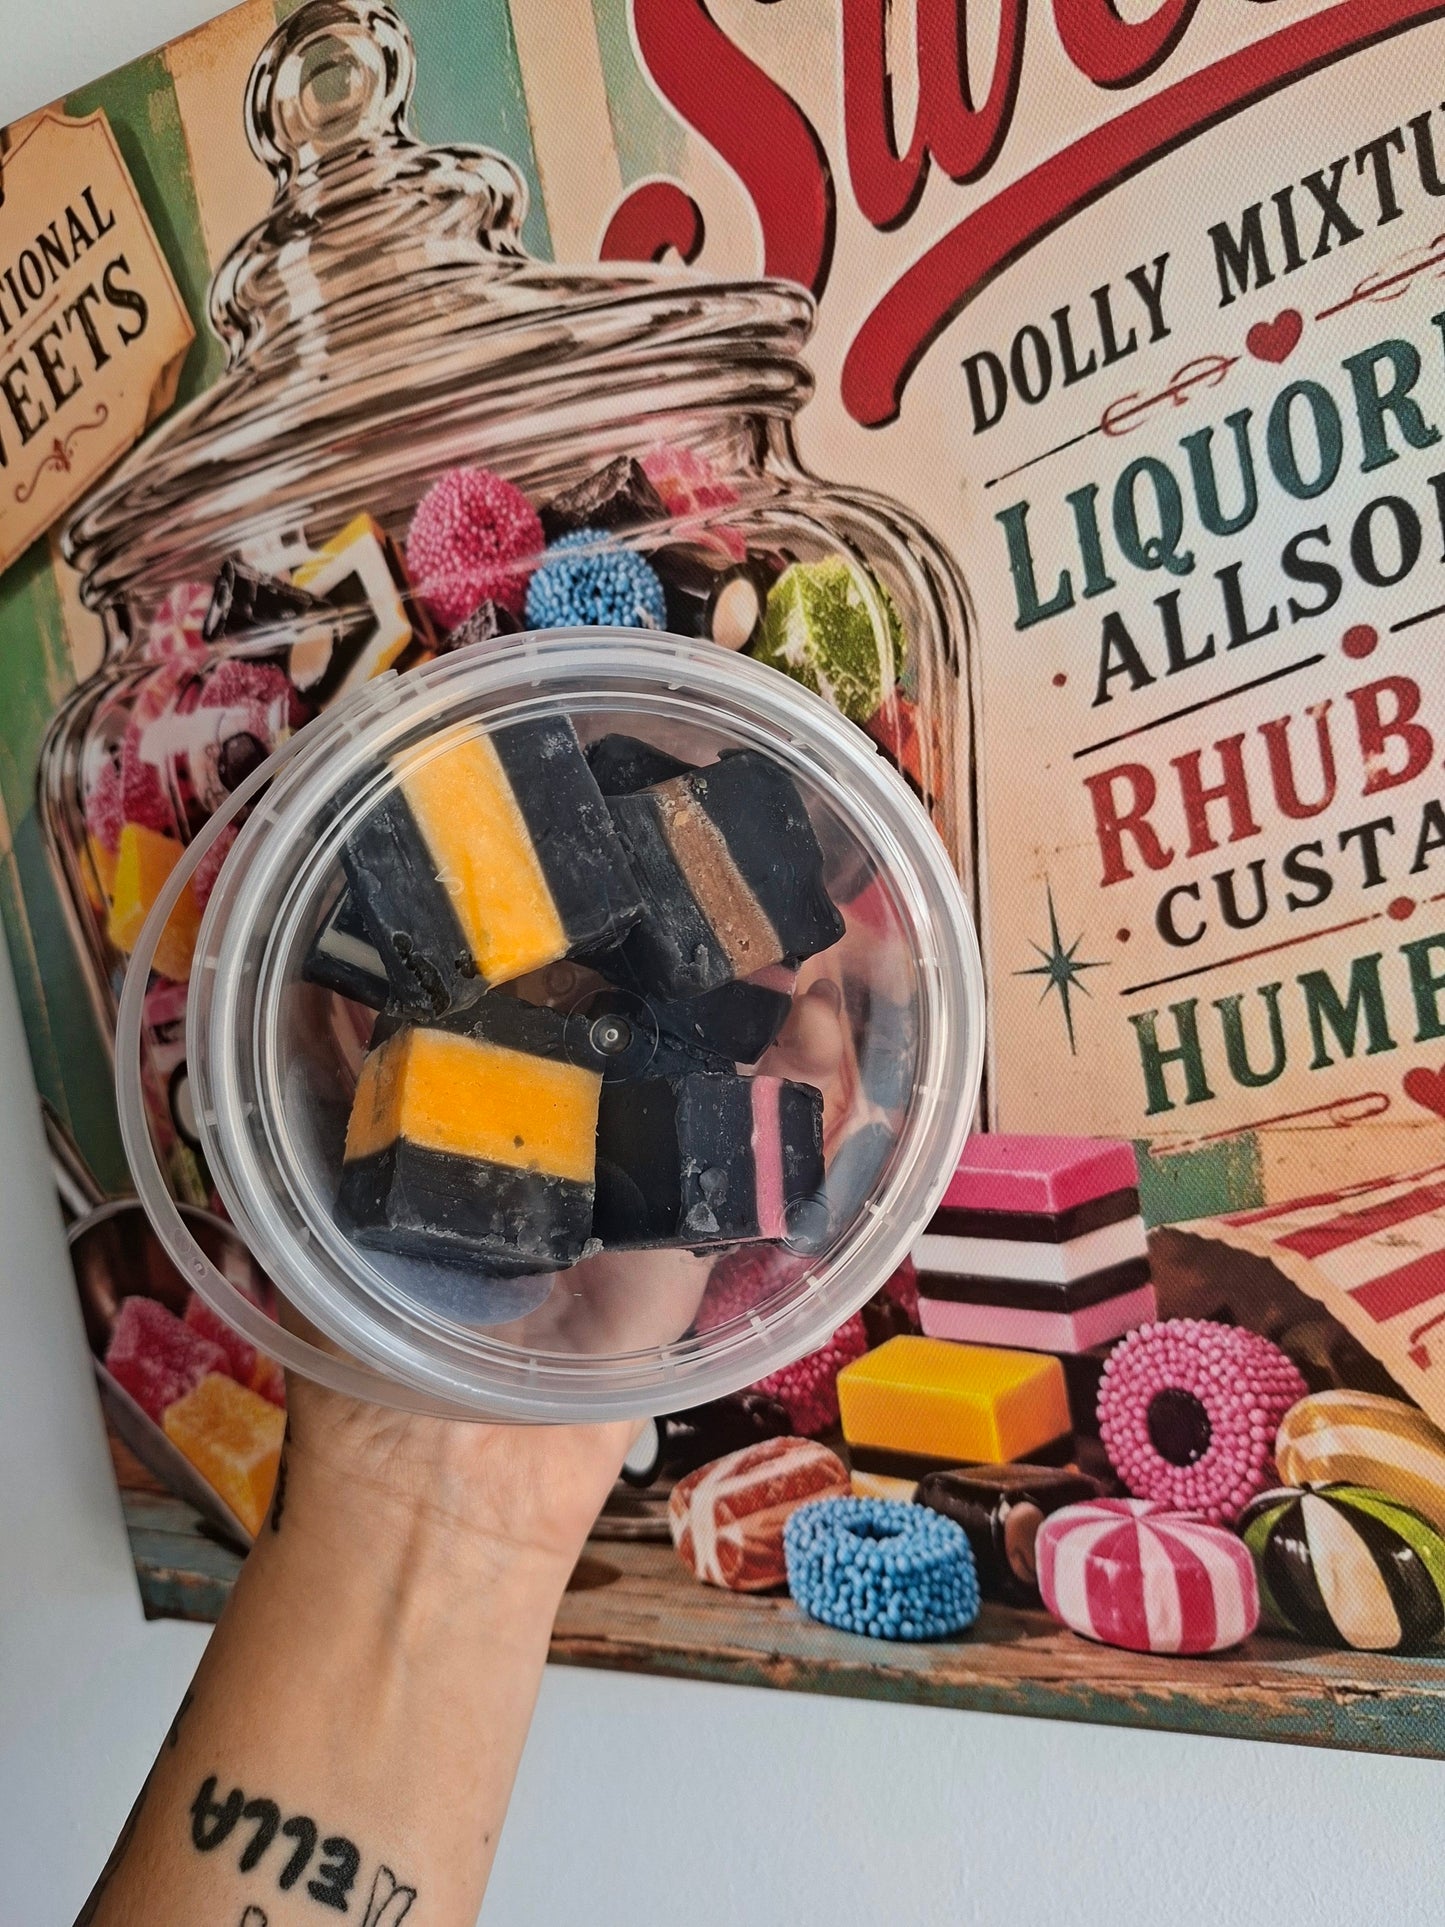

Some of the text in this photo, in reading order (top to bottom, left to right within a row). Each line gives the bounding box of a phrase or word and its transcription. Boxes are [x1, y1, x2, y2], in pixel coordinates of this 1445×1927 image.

[0, 252, 149, 468] EETS
[960, 252, 1173, 435] DOLLY
[995, 310, 1445, 631] LIQUOR
[1091, 471, 1445, 708] ALLSO
[189, 1773, 361, 1912] ELLA
